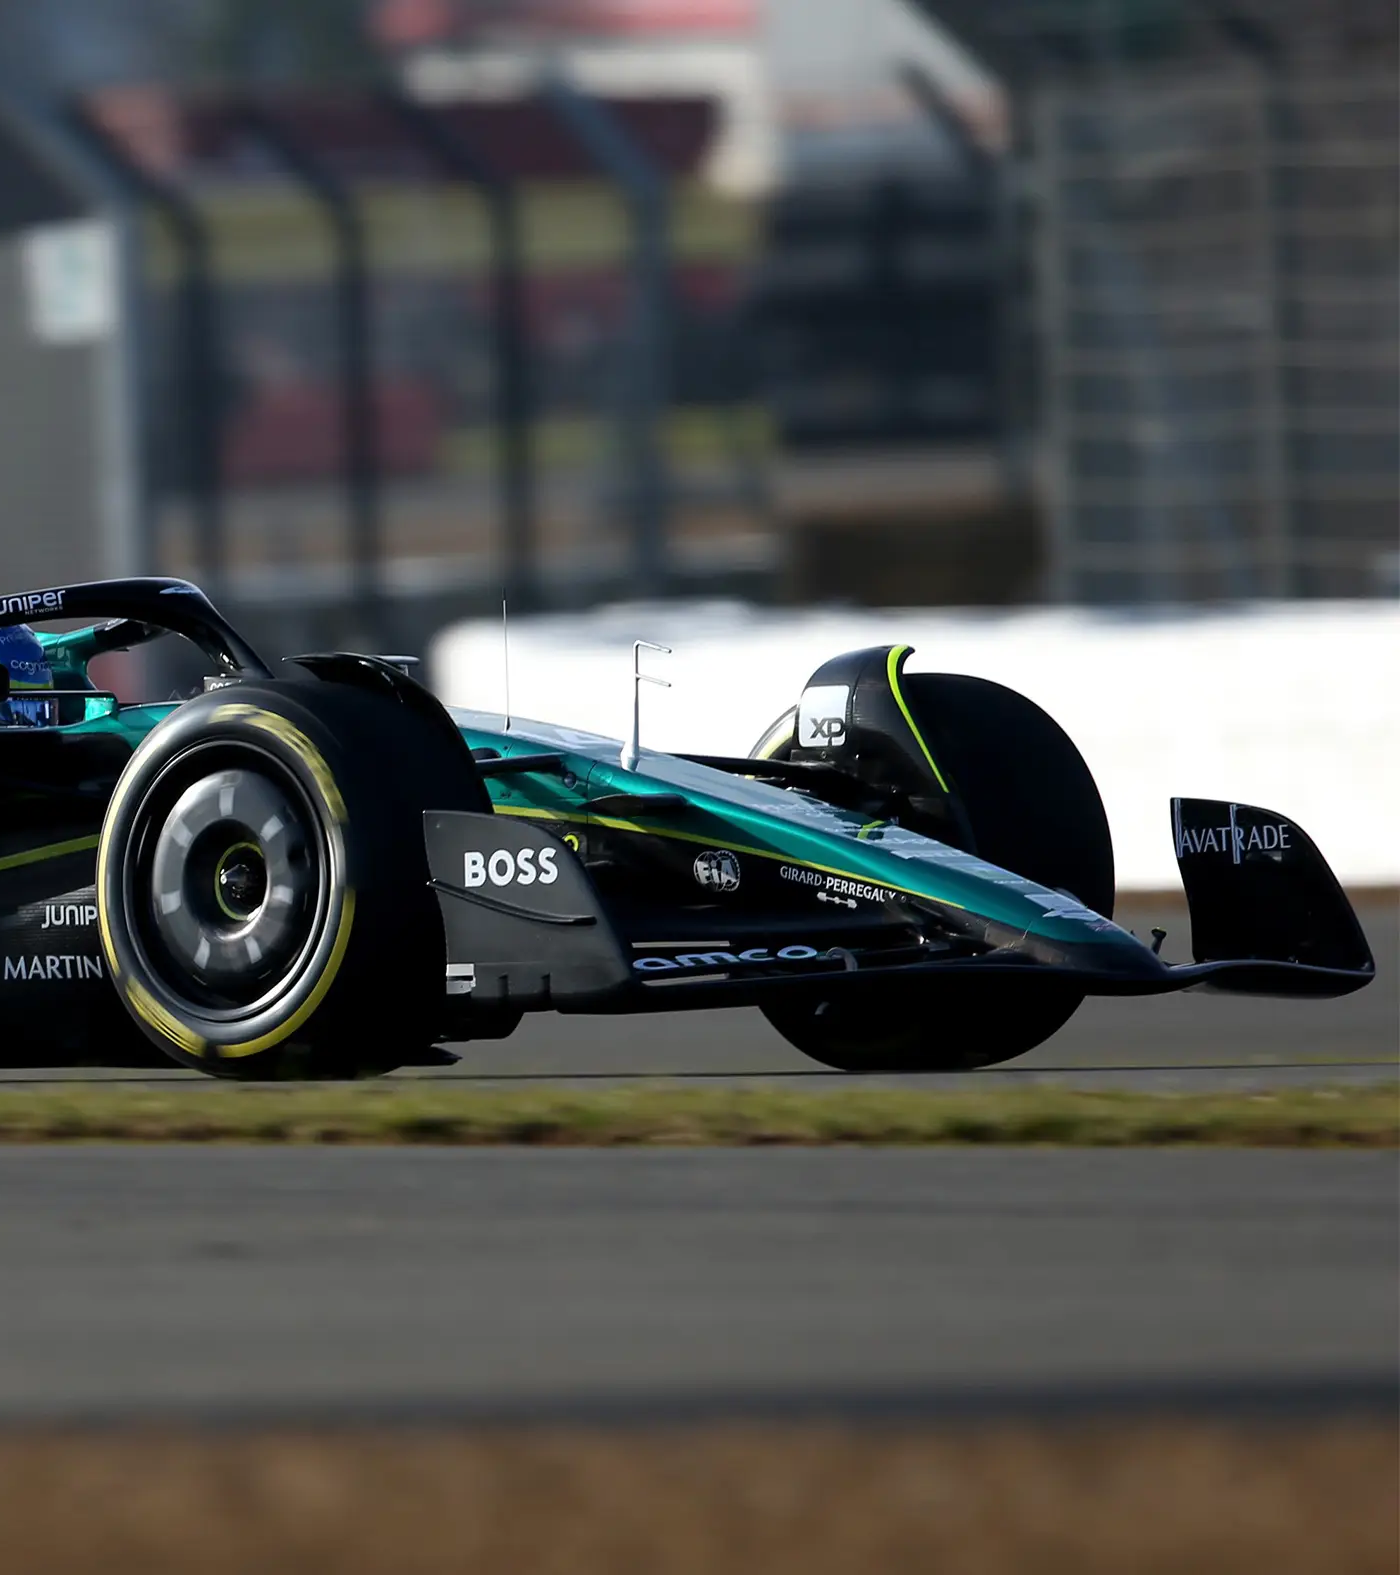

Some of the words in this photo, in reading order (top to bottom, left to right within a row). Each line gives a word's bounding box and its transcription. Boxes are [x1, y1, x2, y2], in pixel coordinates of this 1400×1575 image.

[25, 606, 63, 616] NETWORKS
[1180, 824, 1292, 853] AVATRADE
[464, 847, 558, 887] BOSS
[4, 956, 103, 980] MARTIN
